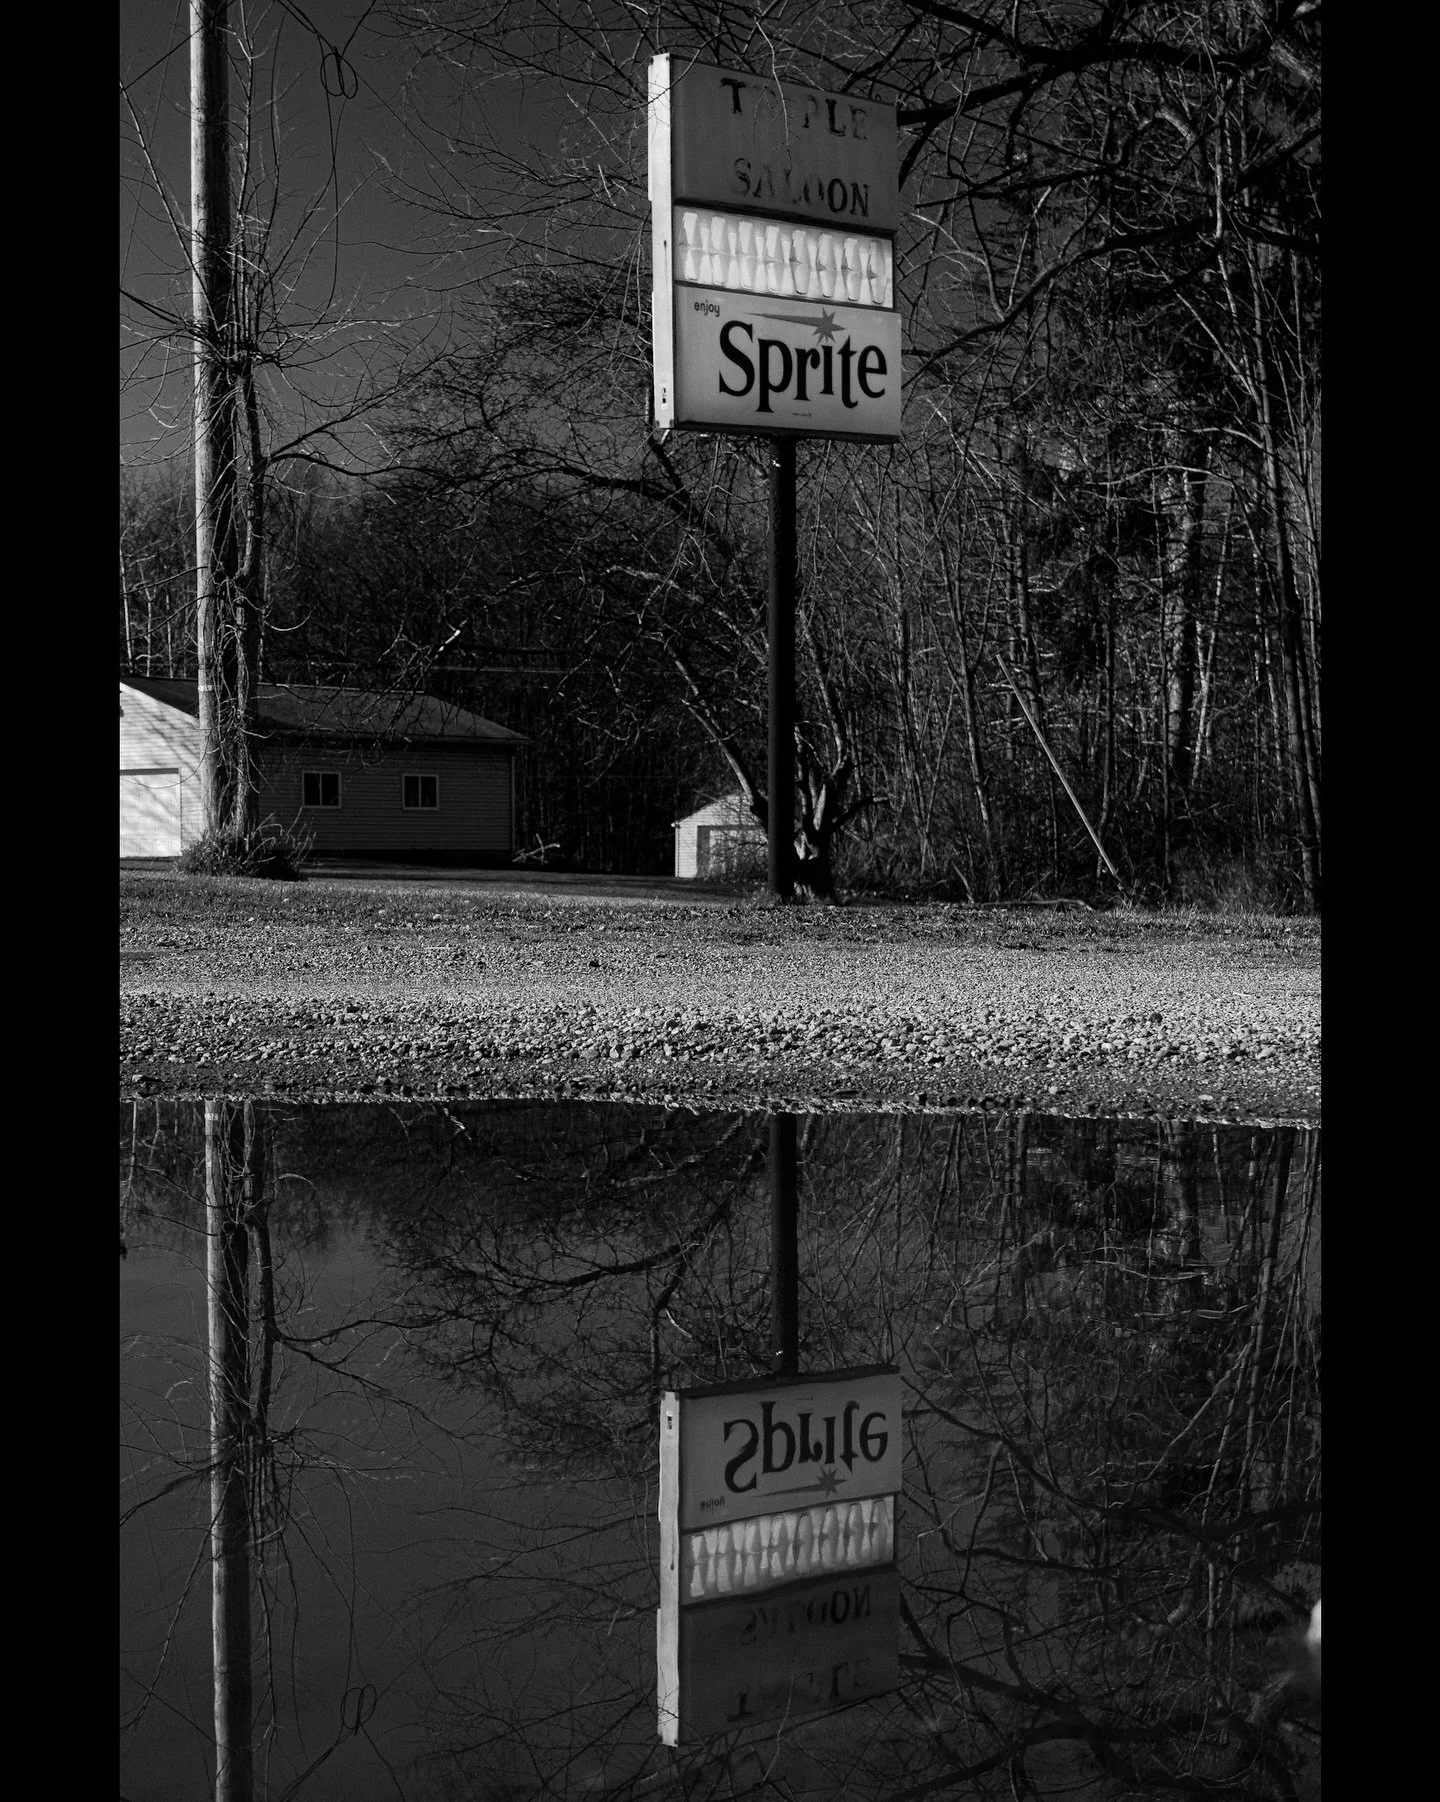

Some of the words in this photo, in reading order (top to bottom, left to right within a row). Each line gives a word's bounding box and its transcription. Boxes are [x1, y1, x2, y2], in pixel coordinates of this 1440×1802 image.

[720, 77, 868, 140] TPLE
[694, 299, 720, 317] enjoy
[718, 319, 888, 413] Sprite
